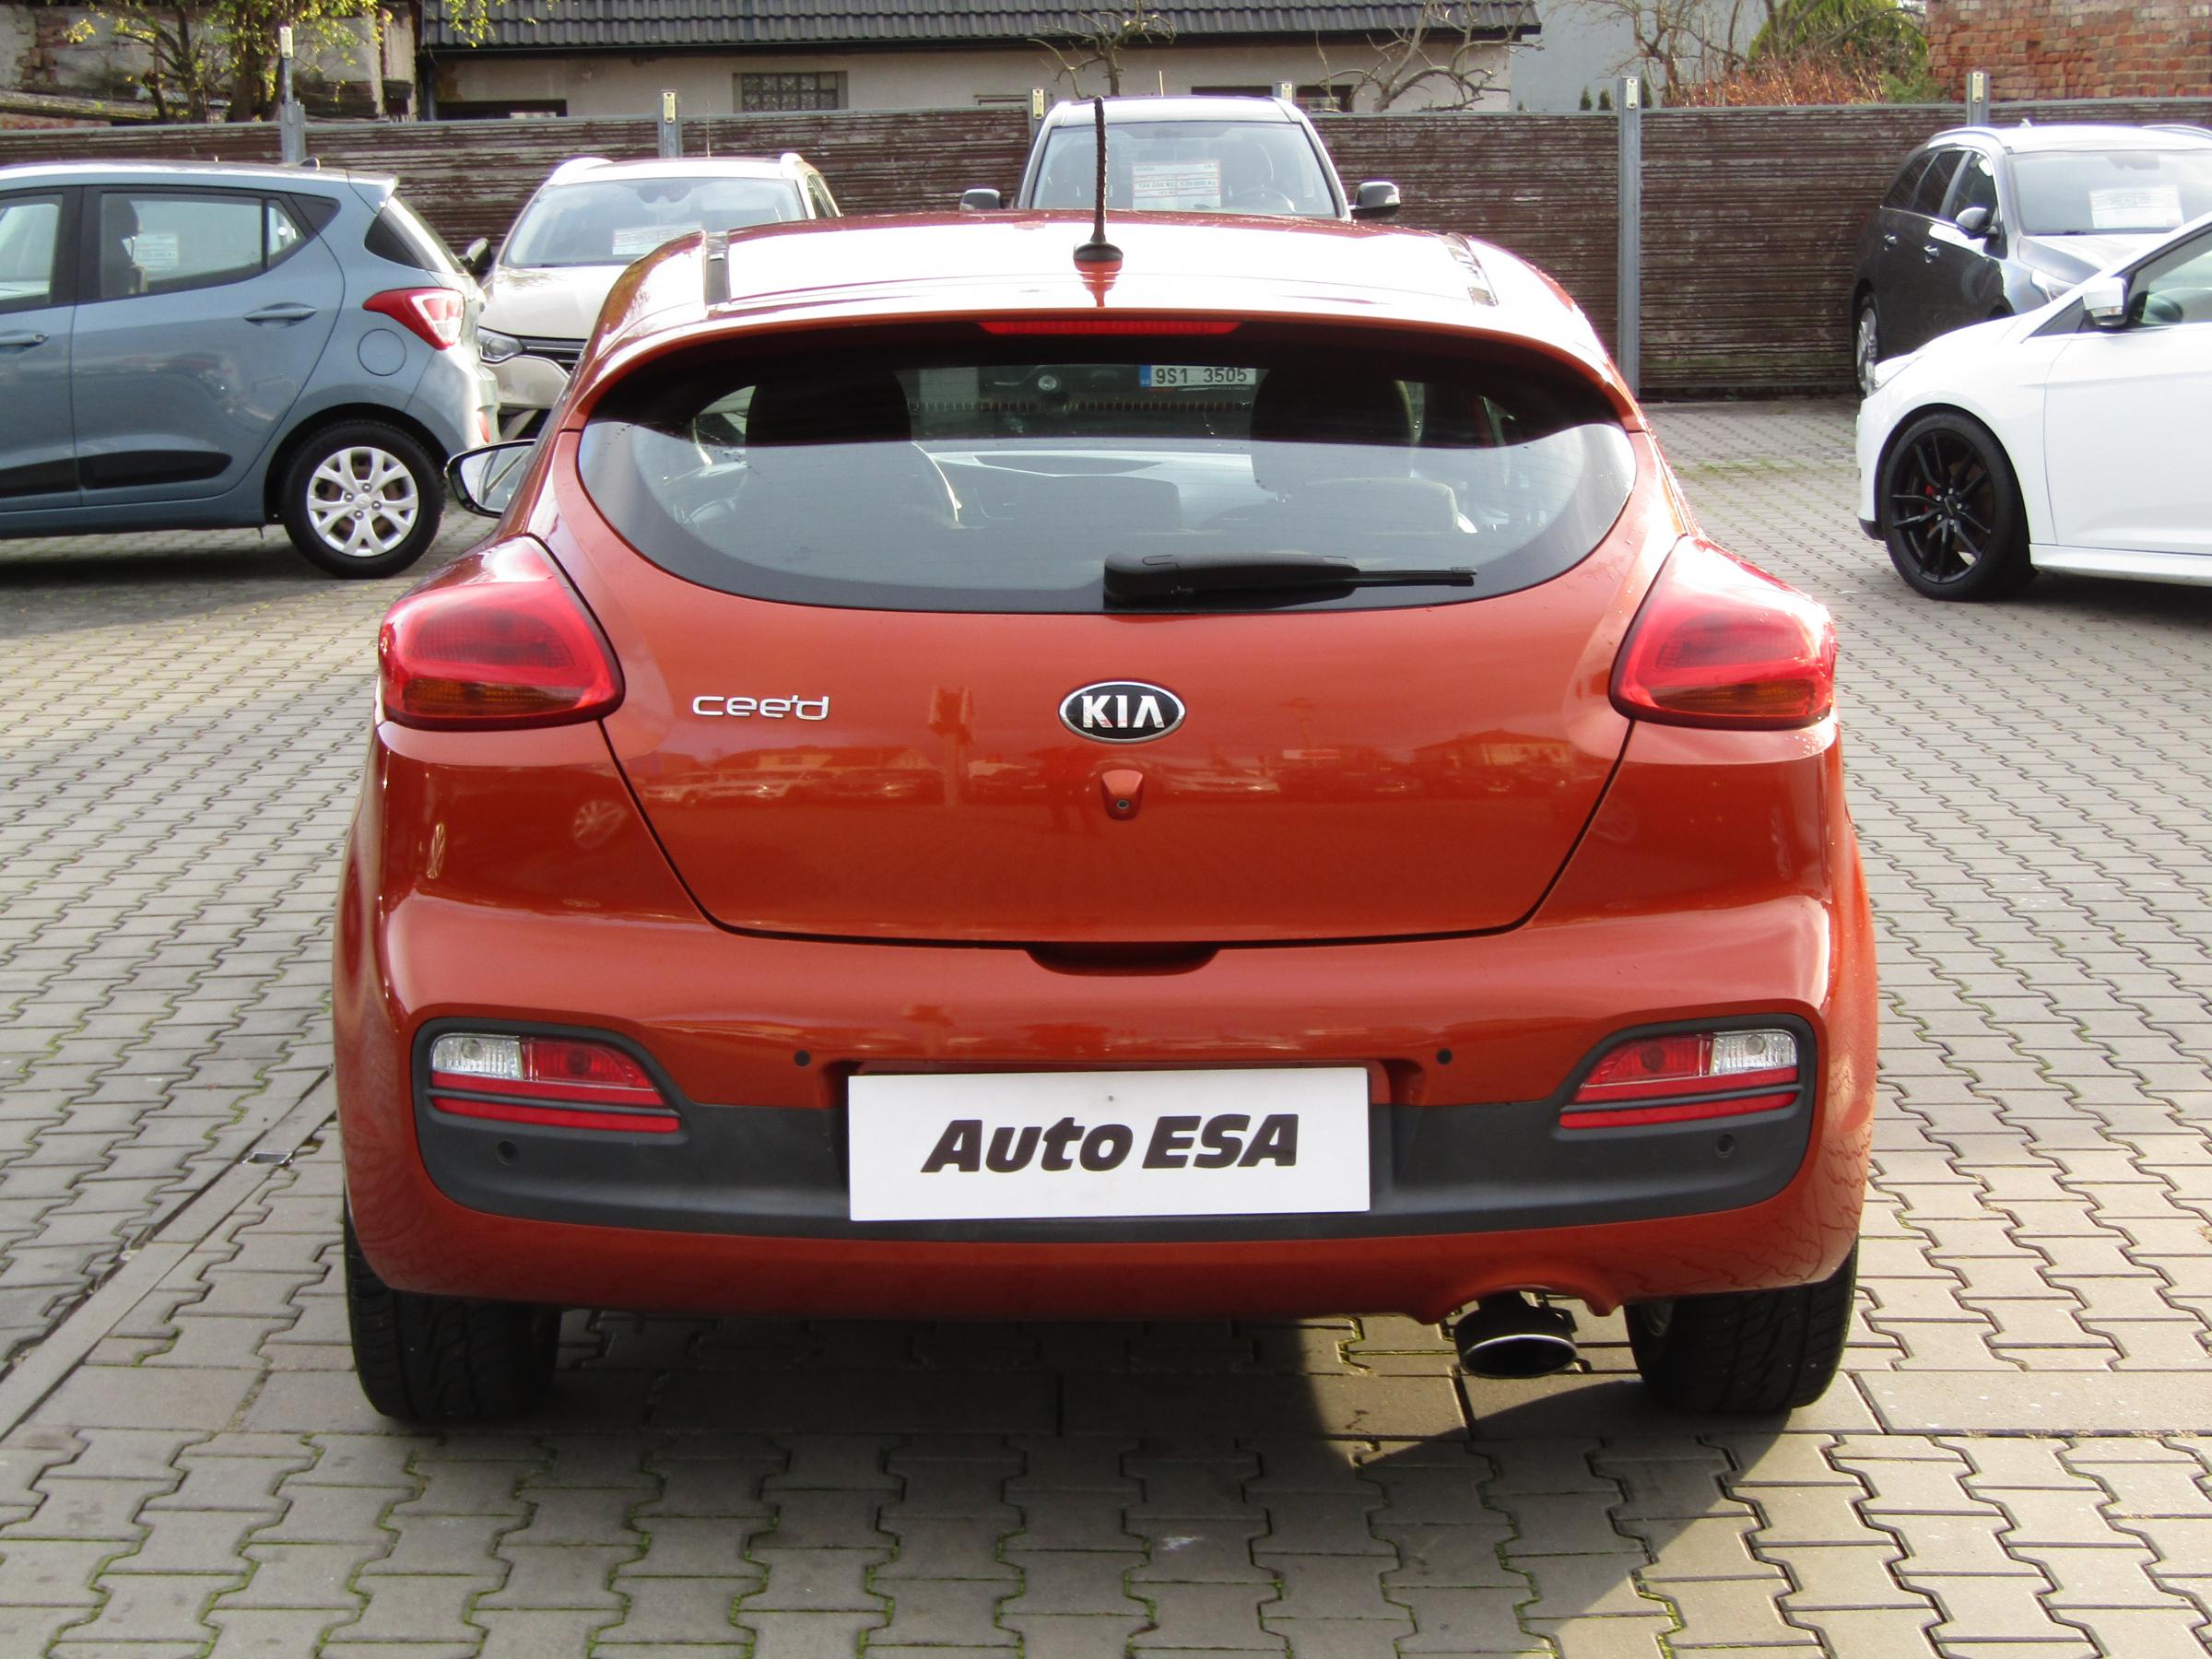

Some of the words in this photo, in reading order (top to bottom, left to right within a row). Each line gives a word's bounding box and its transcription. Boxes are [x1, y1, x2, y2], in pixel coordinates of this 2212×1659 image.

[1156, 368, 1189, 383] 9S1
[1204, 368, 1247, 383] 3505
[692, 694, 830, 720] cee'd
[1082, 694, 1166, 729] KIA
[921, 1116, 1134, 1172] Auto
[1142, 1113, 1300, 1169] ESA
